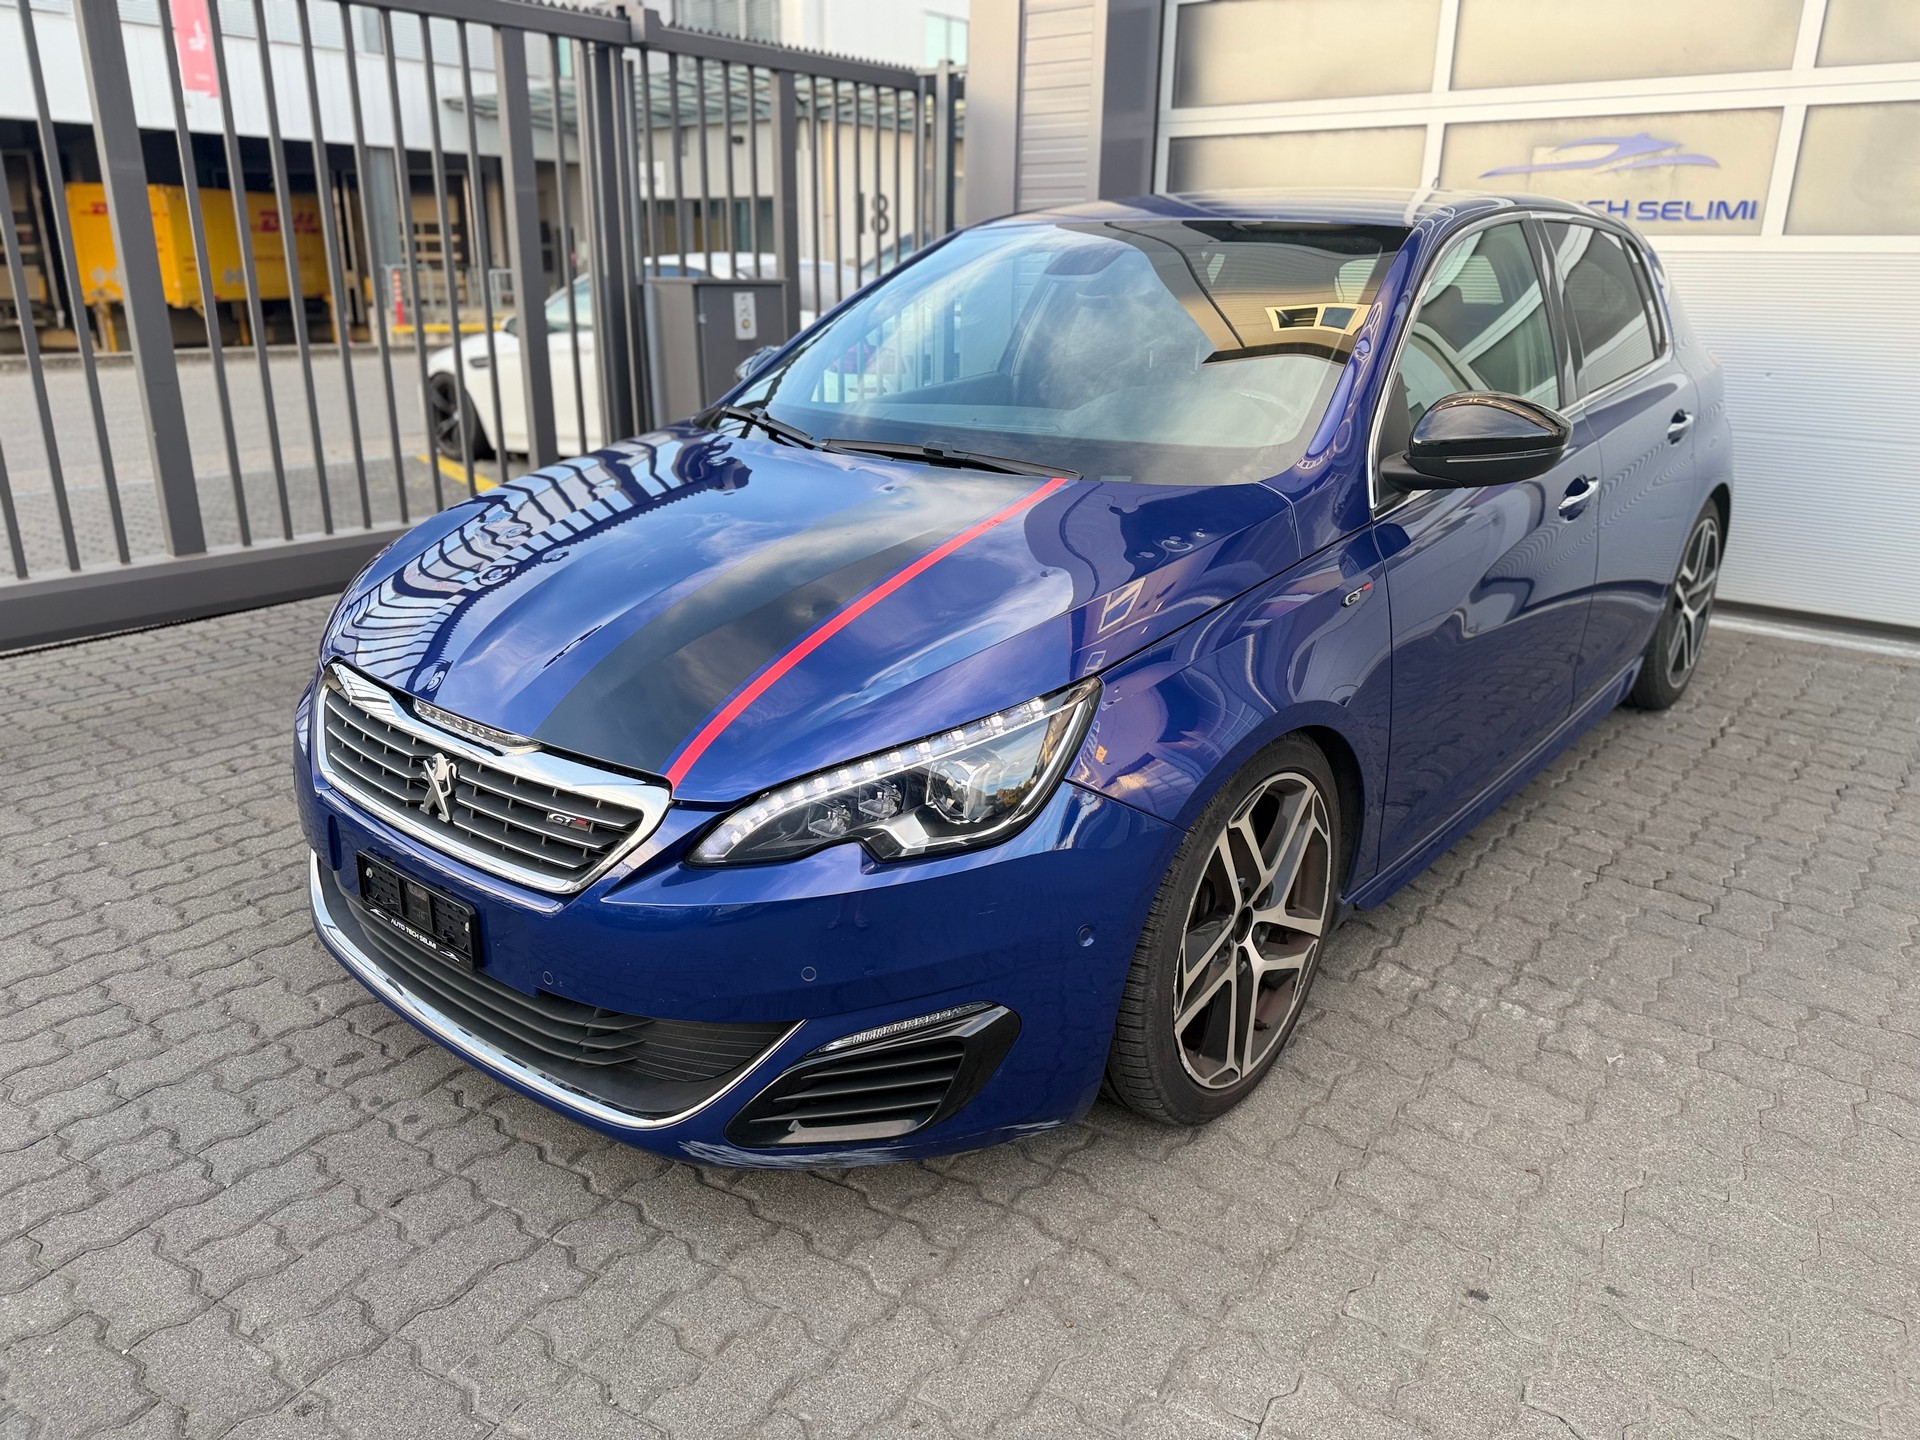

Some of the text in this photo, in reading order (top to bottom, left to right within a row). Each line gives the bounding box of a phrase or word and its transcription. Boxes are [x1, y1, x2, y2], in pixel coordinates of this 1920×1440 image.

[854, 192, 889, 236] 18
[1636, 200, 1758, 221] SELIMI
[390, 918, 406, 931] AUTO
[405, 926, 420, 940] TECH
